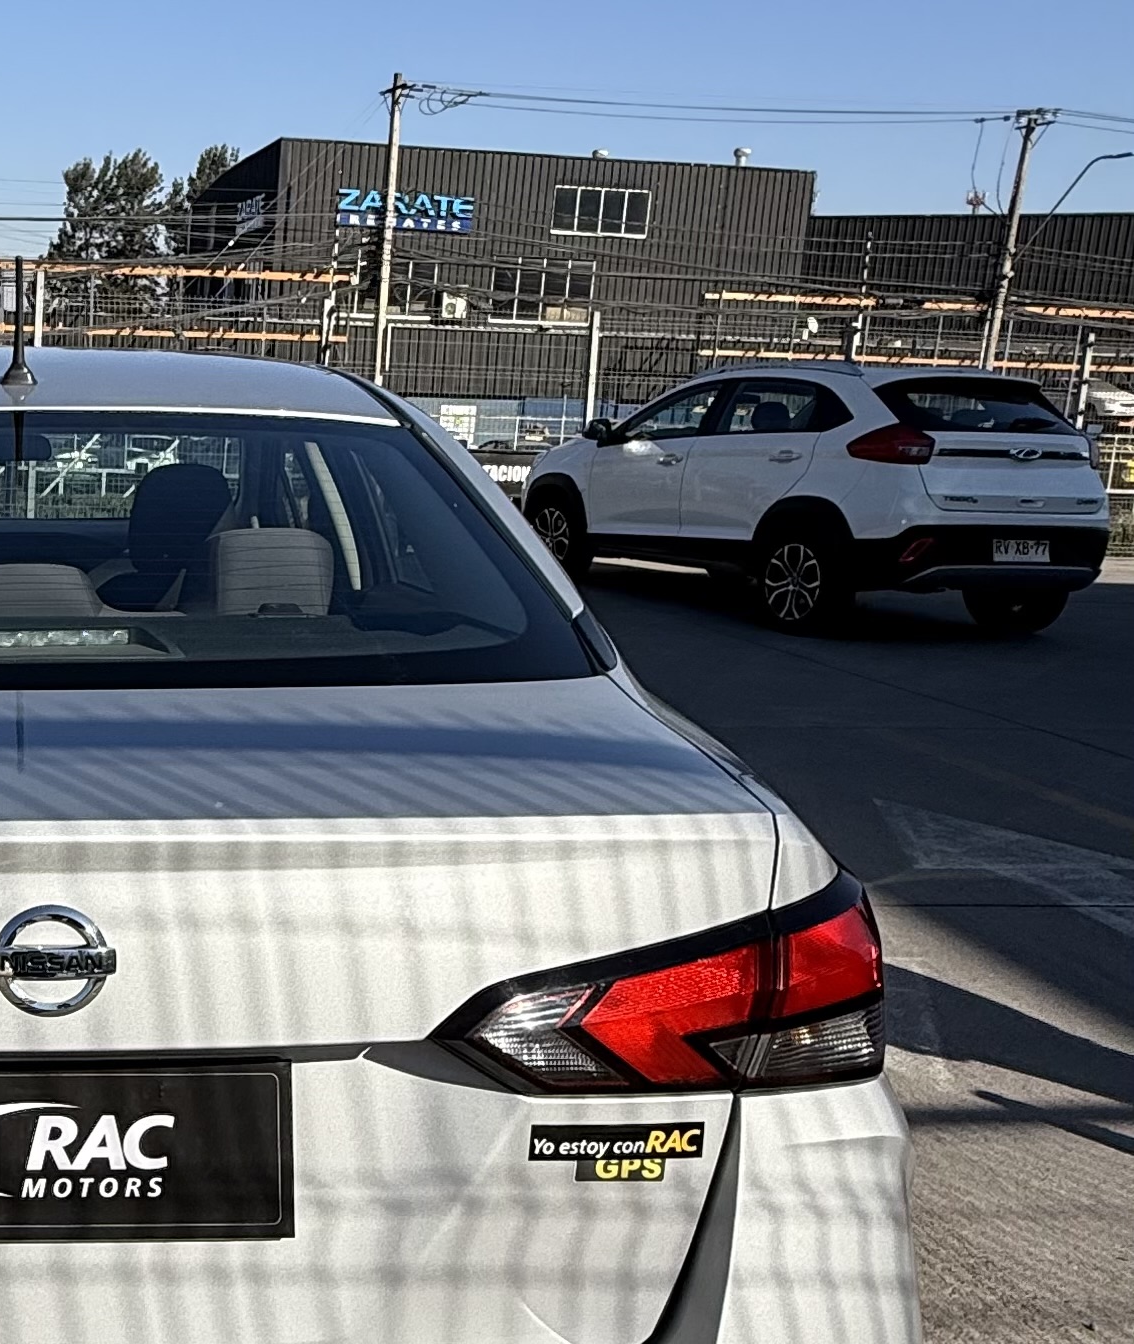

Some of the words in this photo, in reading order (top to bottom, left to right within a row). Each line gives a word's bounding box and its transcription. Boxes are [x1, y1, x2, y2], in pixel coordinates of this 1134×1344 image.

[349, 213, 462, 231] REATES
[0, 949, 104, 975] NISSAN
[26, 1114, 175, 1171] RAC
[533, 1138, 555, 1155] Yo
[558, 1139, 610, 1158] estoy
[595, 1158, 662, 1179] GPS
[20, 1176, 163, 1198] MOTORS
